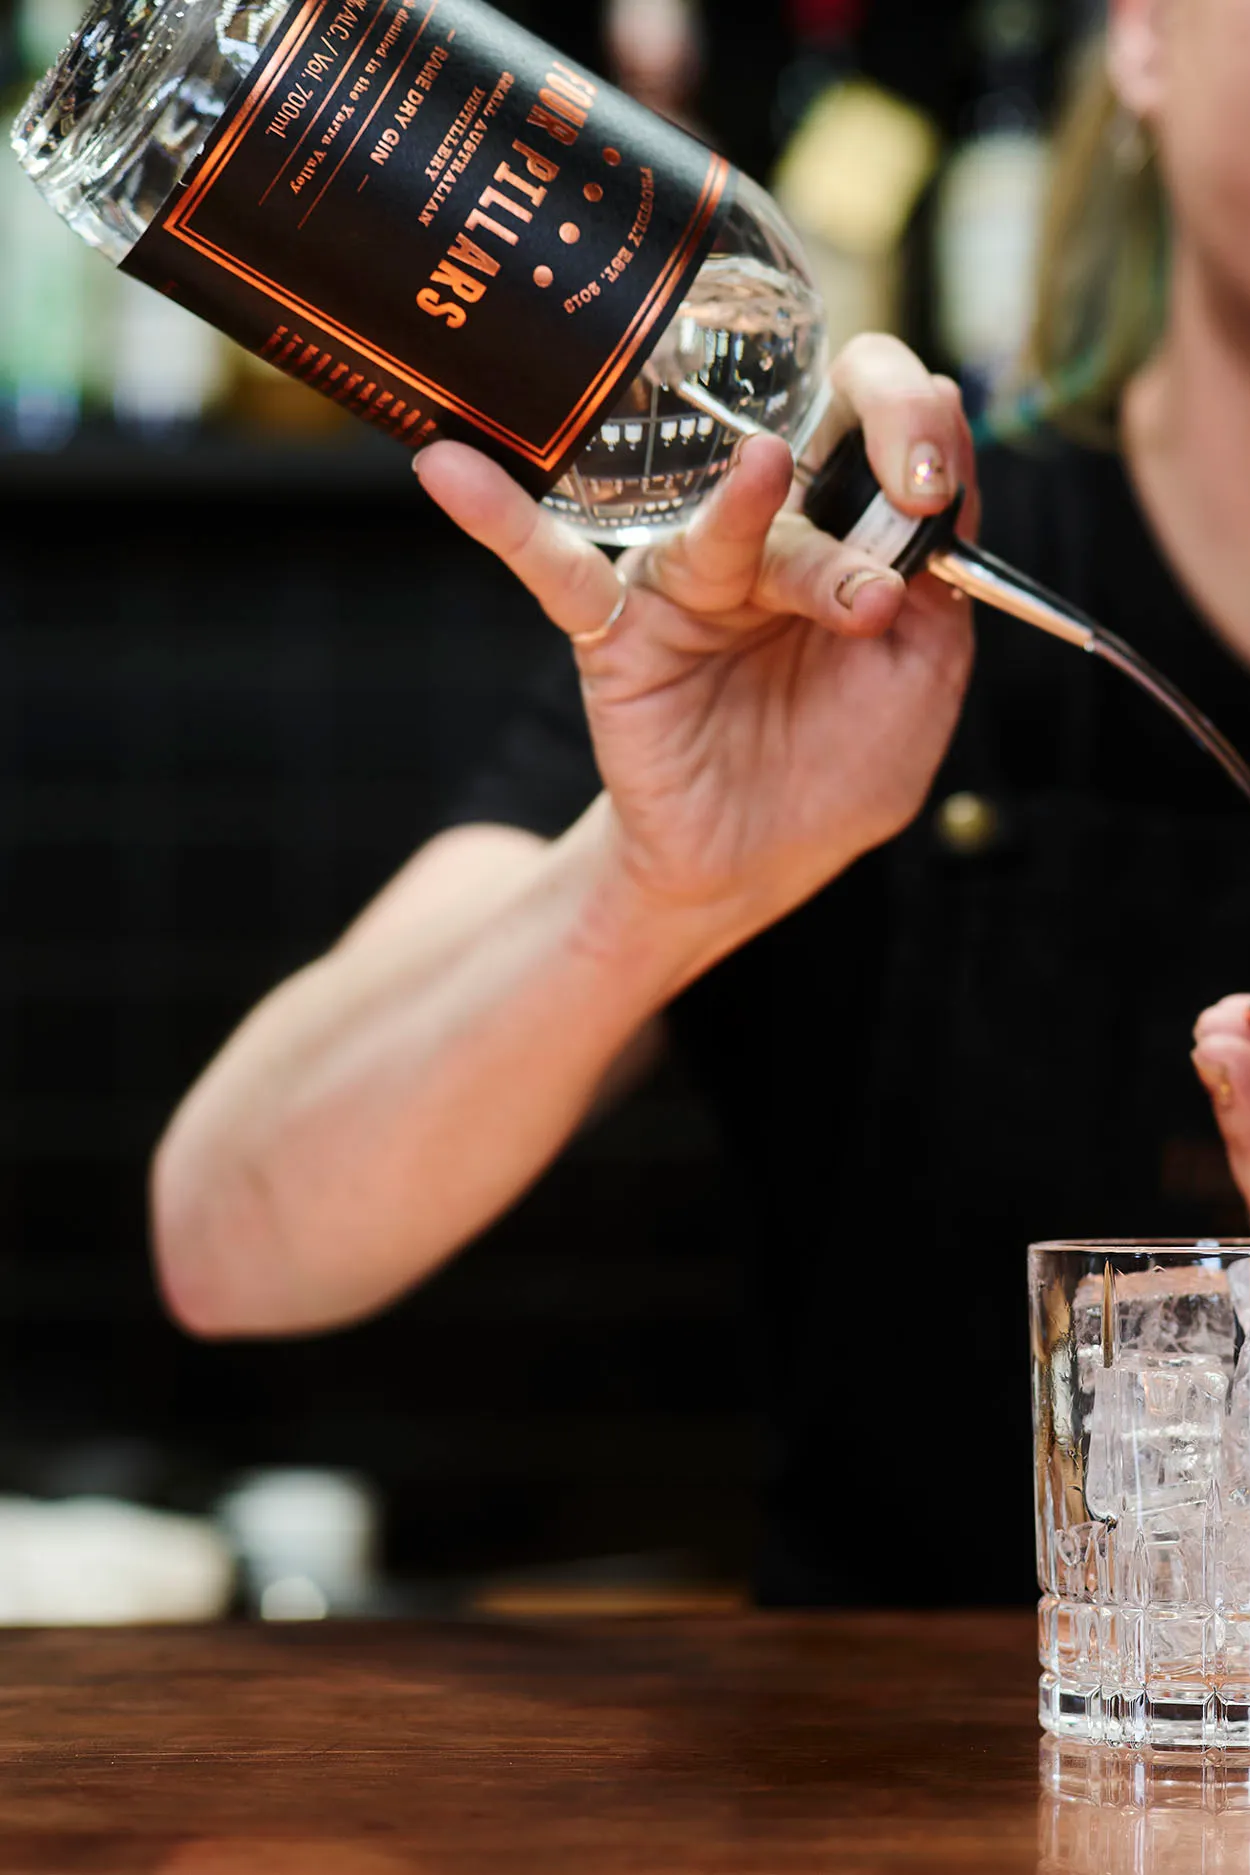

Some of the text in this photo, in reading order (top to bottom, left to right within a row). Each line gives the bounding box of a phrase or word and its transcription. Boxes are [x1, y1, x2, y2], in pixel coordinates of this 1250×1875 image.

[265, 82, 314, 139] 700mL
[289, 7, 410, 195] distilled in the Yarra Valley
[301, 52, 335, 82] Vol.
[370, 46, 448, 167] RARE DRY GIN
[424, 84, 487, 182] DISTILLERY
[416, 60, 598, 329] FOUR PILLARS
[418, 70, 515, 228] SMALL AUSTRALIAN
[563, 166, 655, 314] PROUDLY EST. 2013
